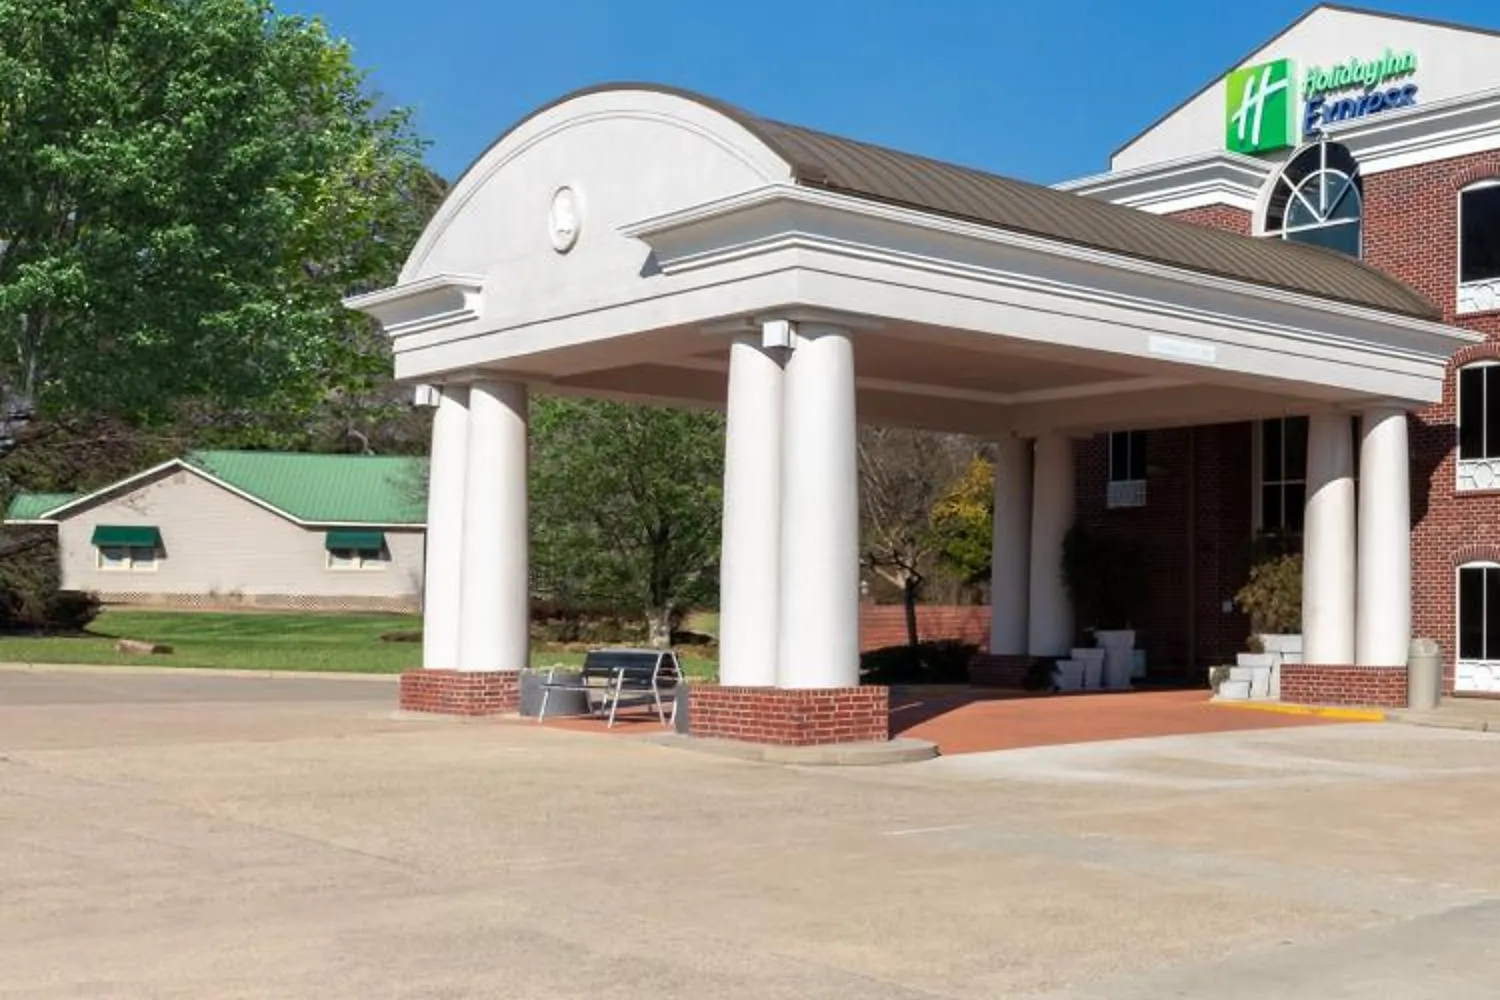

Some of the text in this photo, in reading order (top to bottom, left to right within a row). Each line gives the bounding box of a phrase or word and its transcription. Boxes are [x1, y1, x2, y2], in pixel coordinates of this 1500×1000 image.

[1231, 65, 1289, 146] H
[1302, 47, 1417, 99] Holiday Inn
